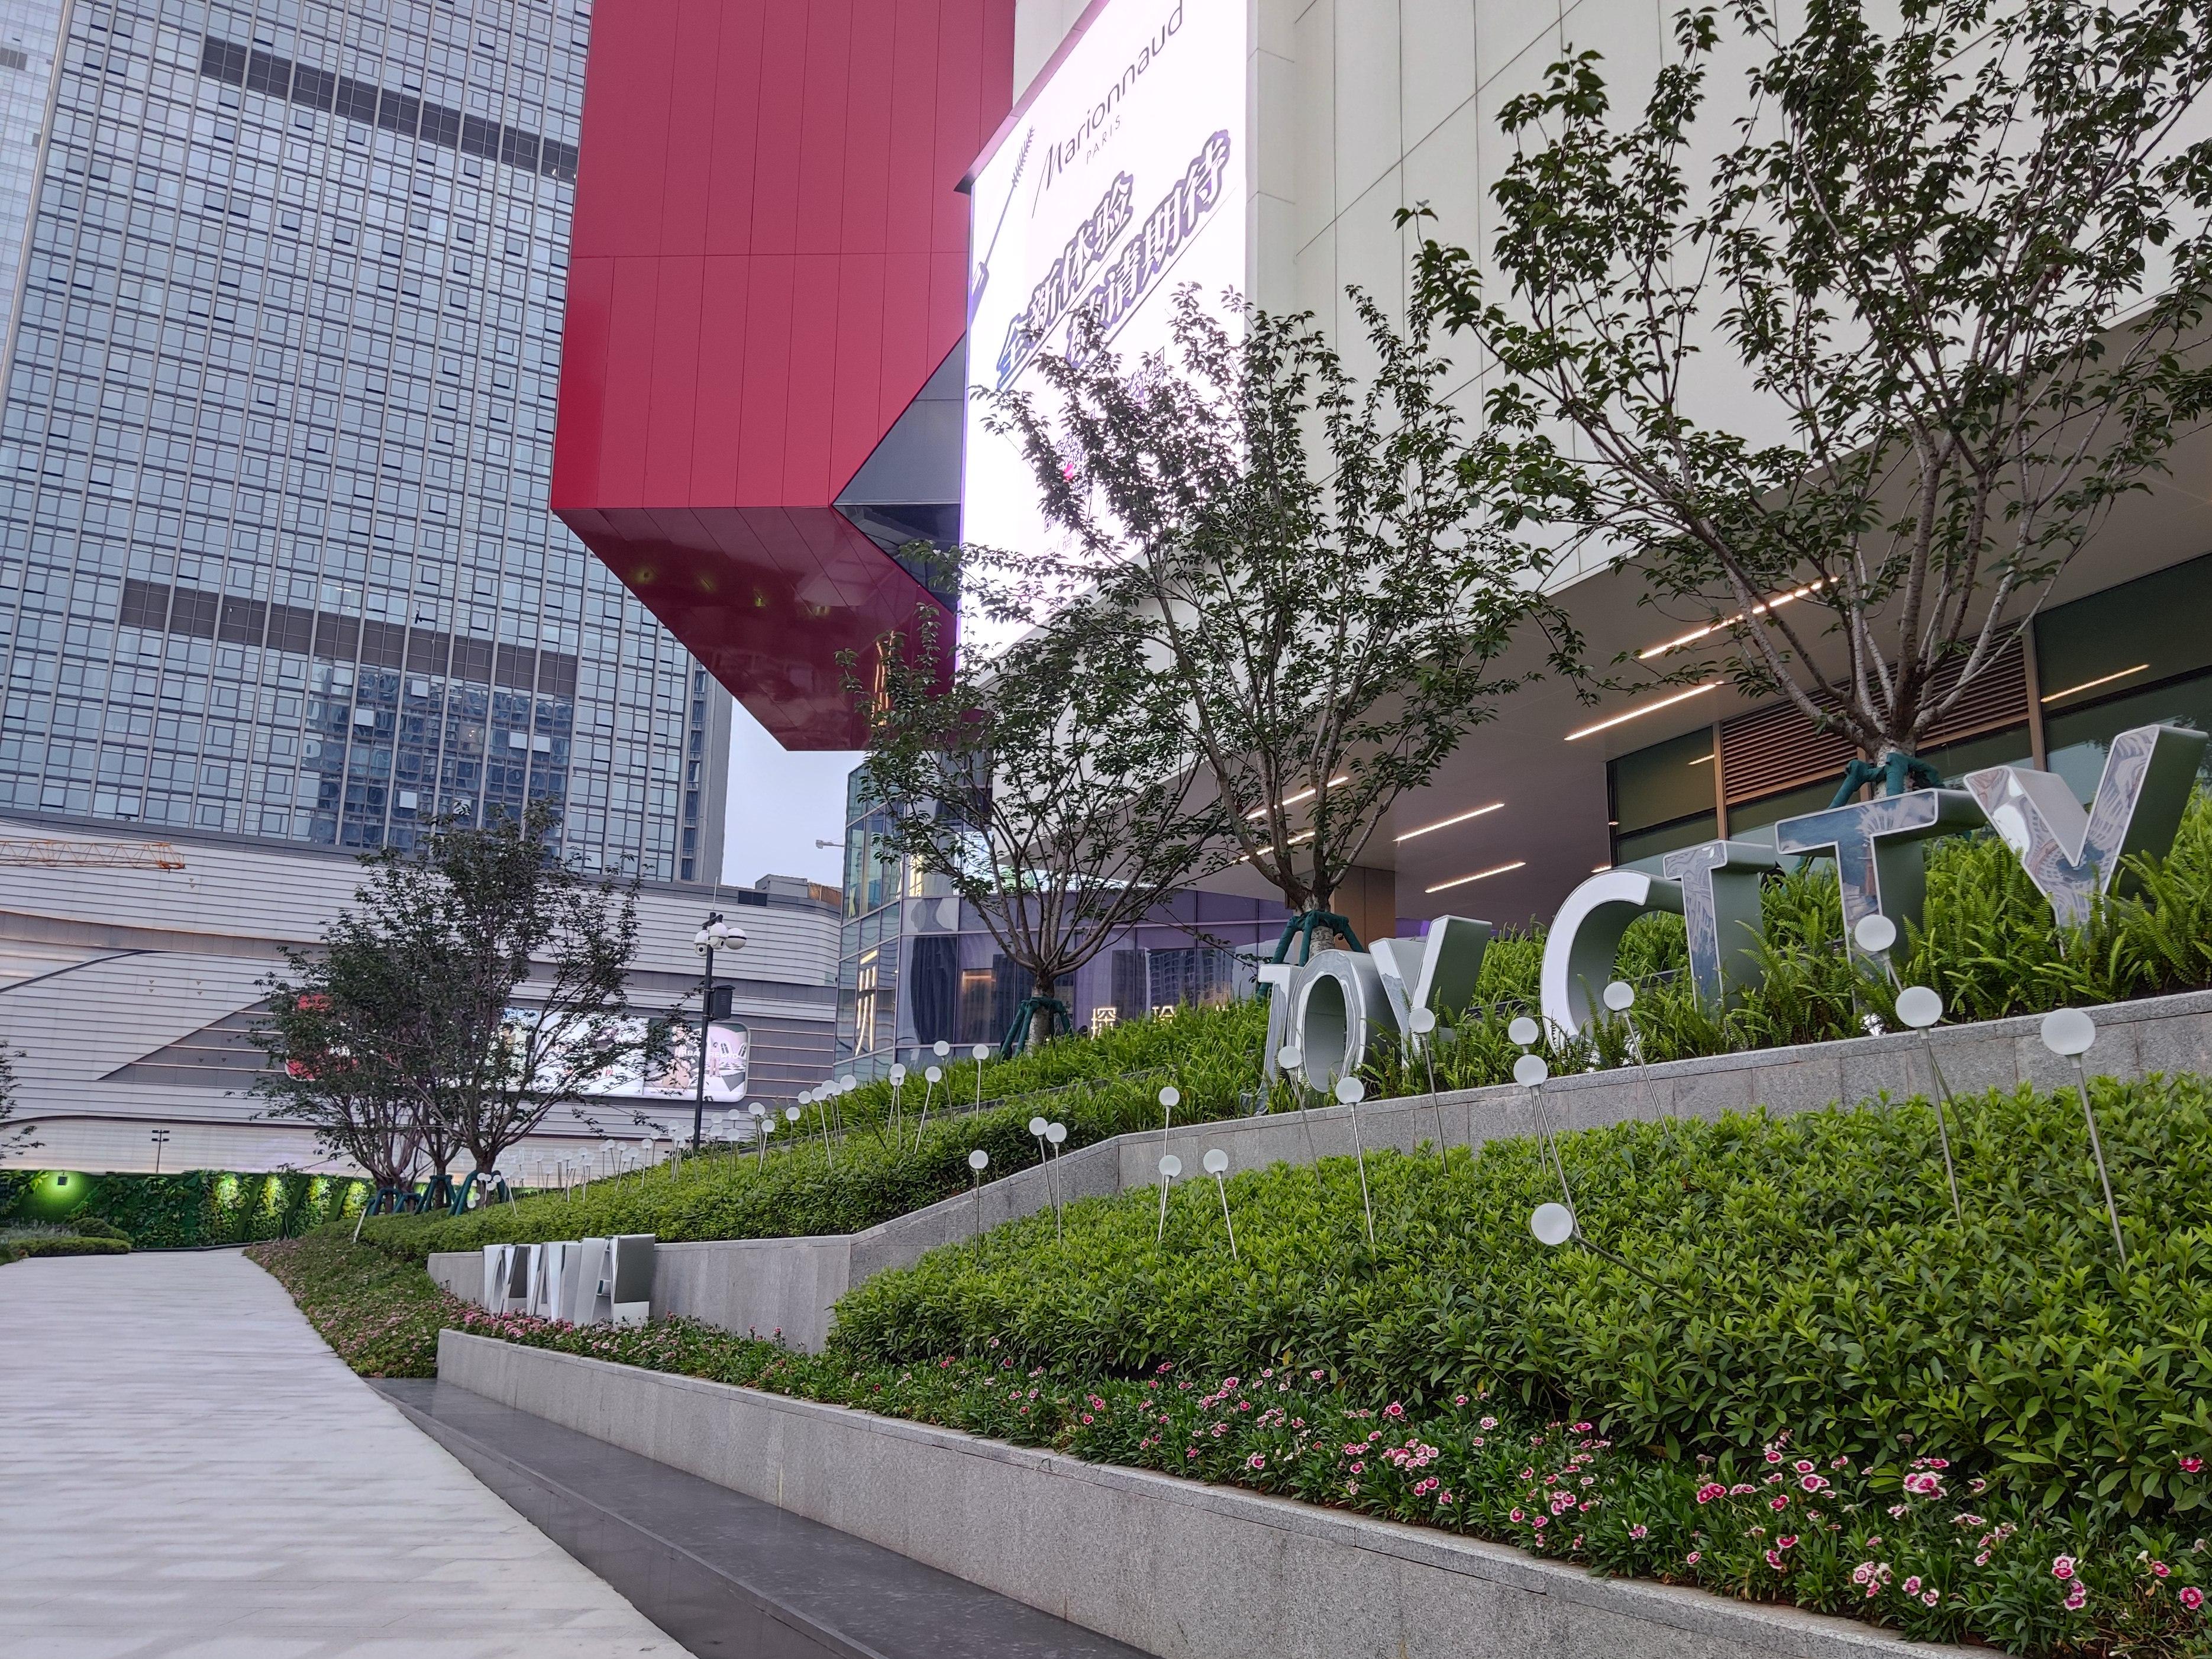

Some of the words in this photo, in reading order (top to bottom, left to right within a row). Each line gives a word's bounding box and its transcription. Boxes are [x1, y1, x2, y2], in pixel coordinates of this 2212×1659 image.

[1032, 0, 1183, 219] Marionnaud
[1086, 115, 1122, 165] PARIS
[997, 170, 1133, 388] 全新体验
[1240, 915, 1449, 1115] JOY
